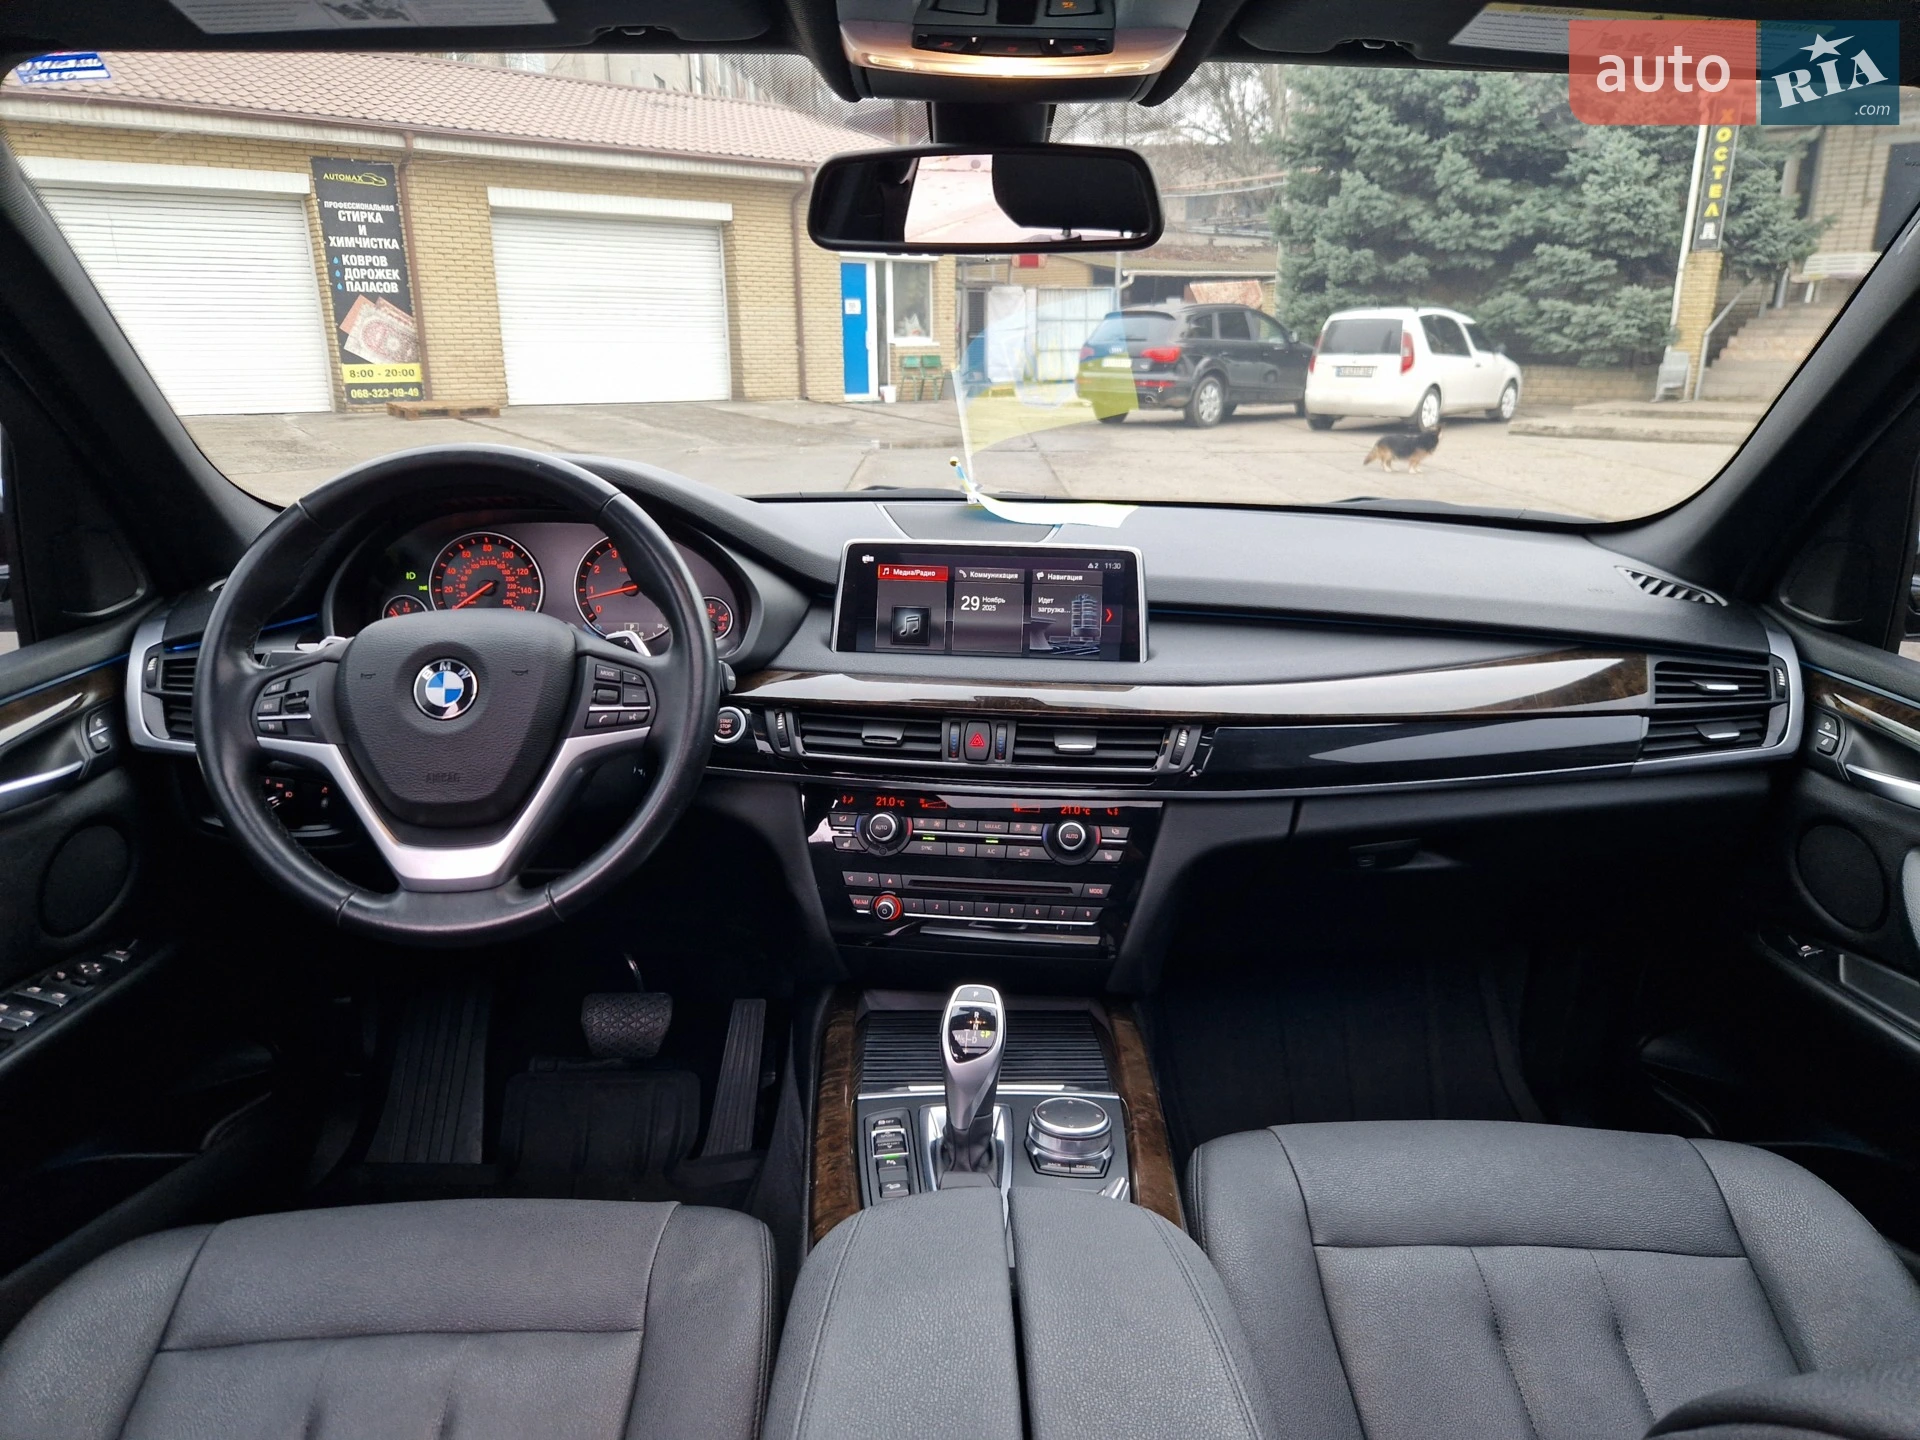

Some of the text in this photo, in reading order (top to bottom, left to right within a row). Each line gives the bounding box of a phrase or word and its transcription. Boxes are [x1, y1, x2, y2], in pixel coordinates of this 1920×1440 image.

[323, 172, 363, 182] AUTOMAX
[324, 201, 395, 212] ПРОФЕССИОНАЛЬНАЯ
[337, 210, 384, 224] СТИРКА
[358, 224, 368, 236] И
[328, 236, 400, 249] ХИМЧИСТКА
[341, 254, 388, 267] КОВРОВ
[344, 267, 401, 281] ДОРОЖЕК
[345, 281, 399, 293] ПАЛАСОВ
[349, 369, 374, 378] 8:00
[384, 368, 415, 377] 20:00
[350, 387, 419, 399] 068-323-09-49
[611, 550, 618, 559] 3
[593, 565, 600, 573] 2
[893, 568, 936, 577] Медиа/Радио
[969, 570, 1018, 579] Коммуникация
[1047, 573, 1083, 581] Навигация
[960, 595, 980, 611] 29
[982, 596, 1006, 604] Ноябрь
[595, 605, 602, 613] 0
[421, 661, 471, 681] BMW
[876, 796, 895, 807] 21.0
[1060, 805, 1080, 815] 21.0
